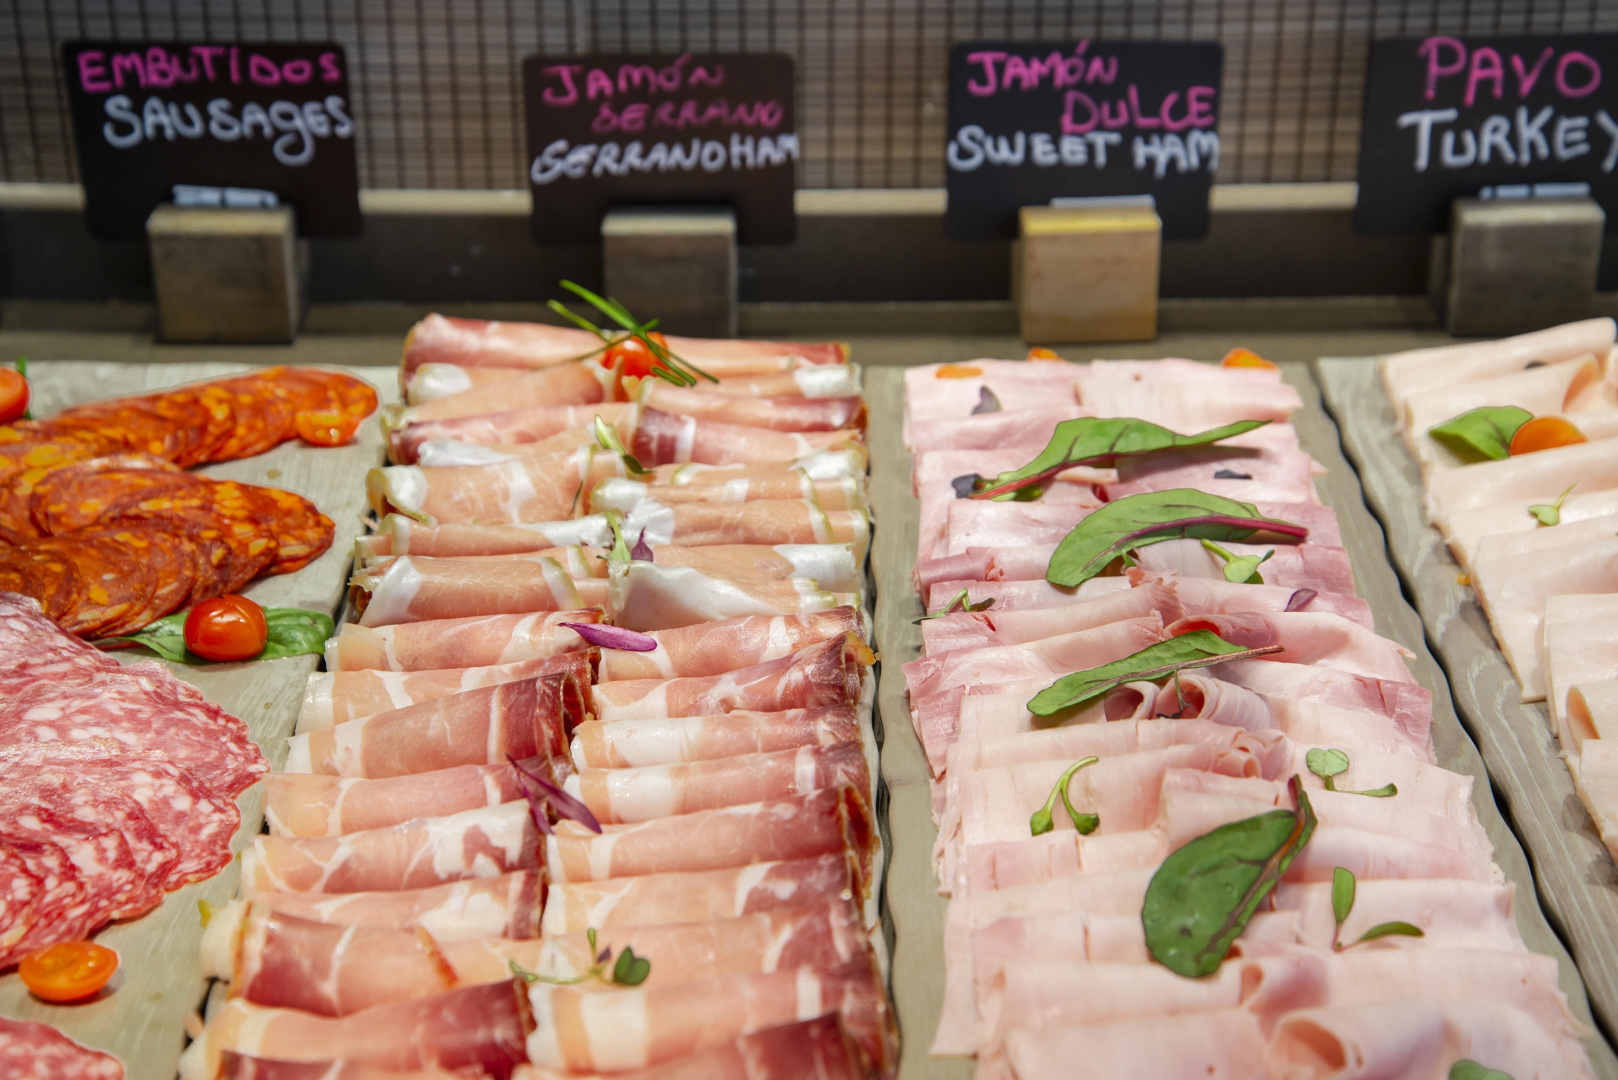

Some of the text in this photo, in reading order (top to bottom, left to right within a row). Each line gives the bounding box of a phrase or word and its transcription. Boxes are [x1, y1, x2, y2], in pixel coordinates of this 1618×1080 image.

[77, 47, 341, 92] EMBUTIDOS
[967, 38, 1118, 97] JAMÓN
[1418, 36, 1602, 107] PAVO
[1060, 83, 1216, 134] DULCE
[947, 124, 1220, 179] SWEET HAM
